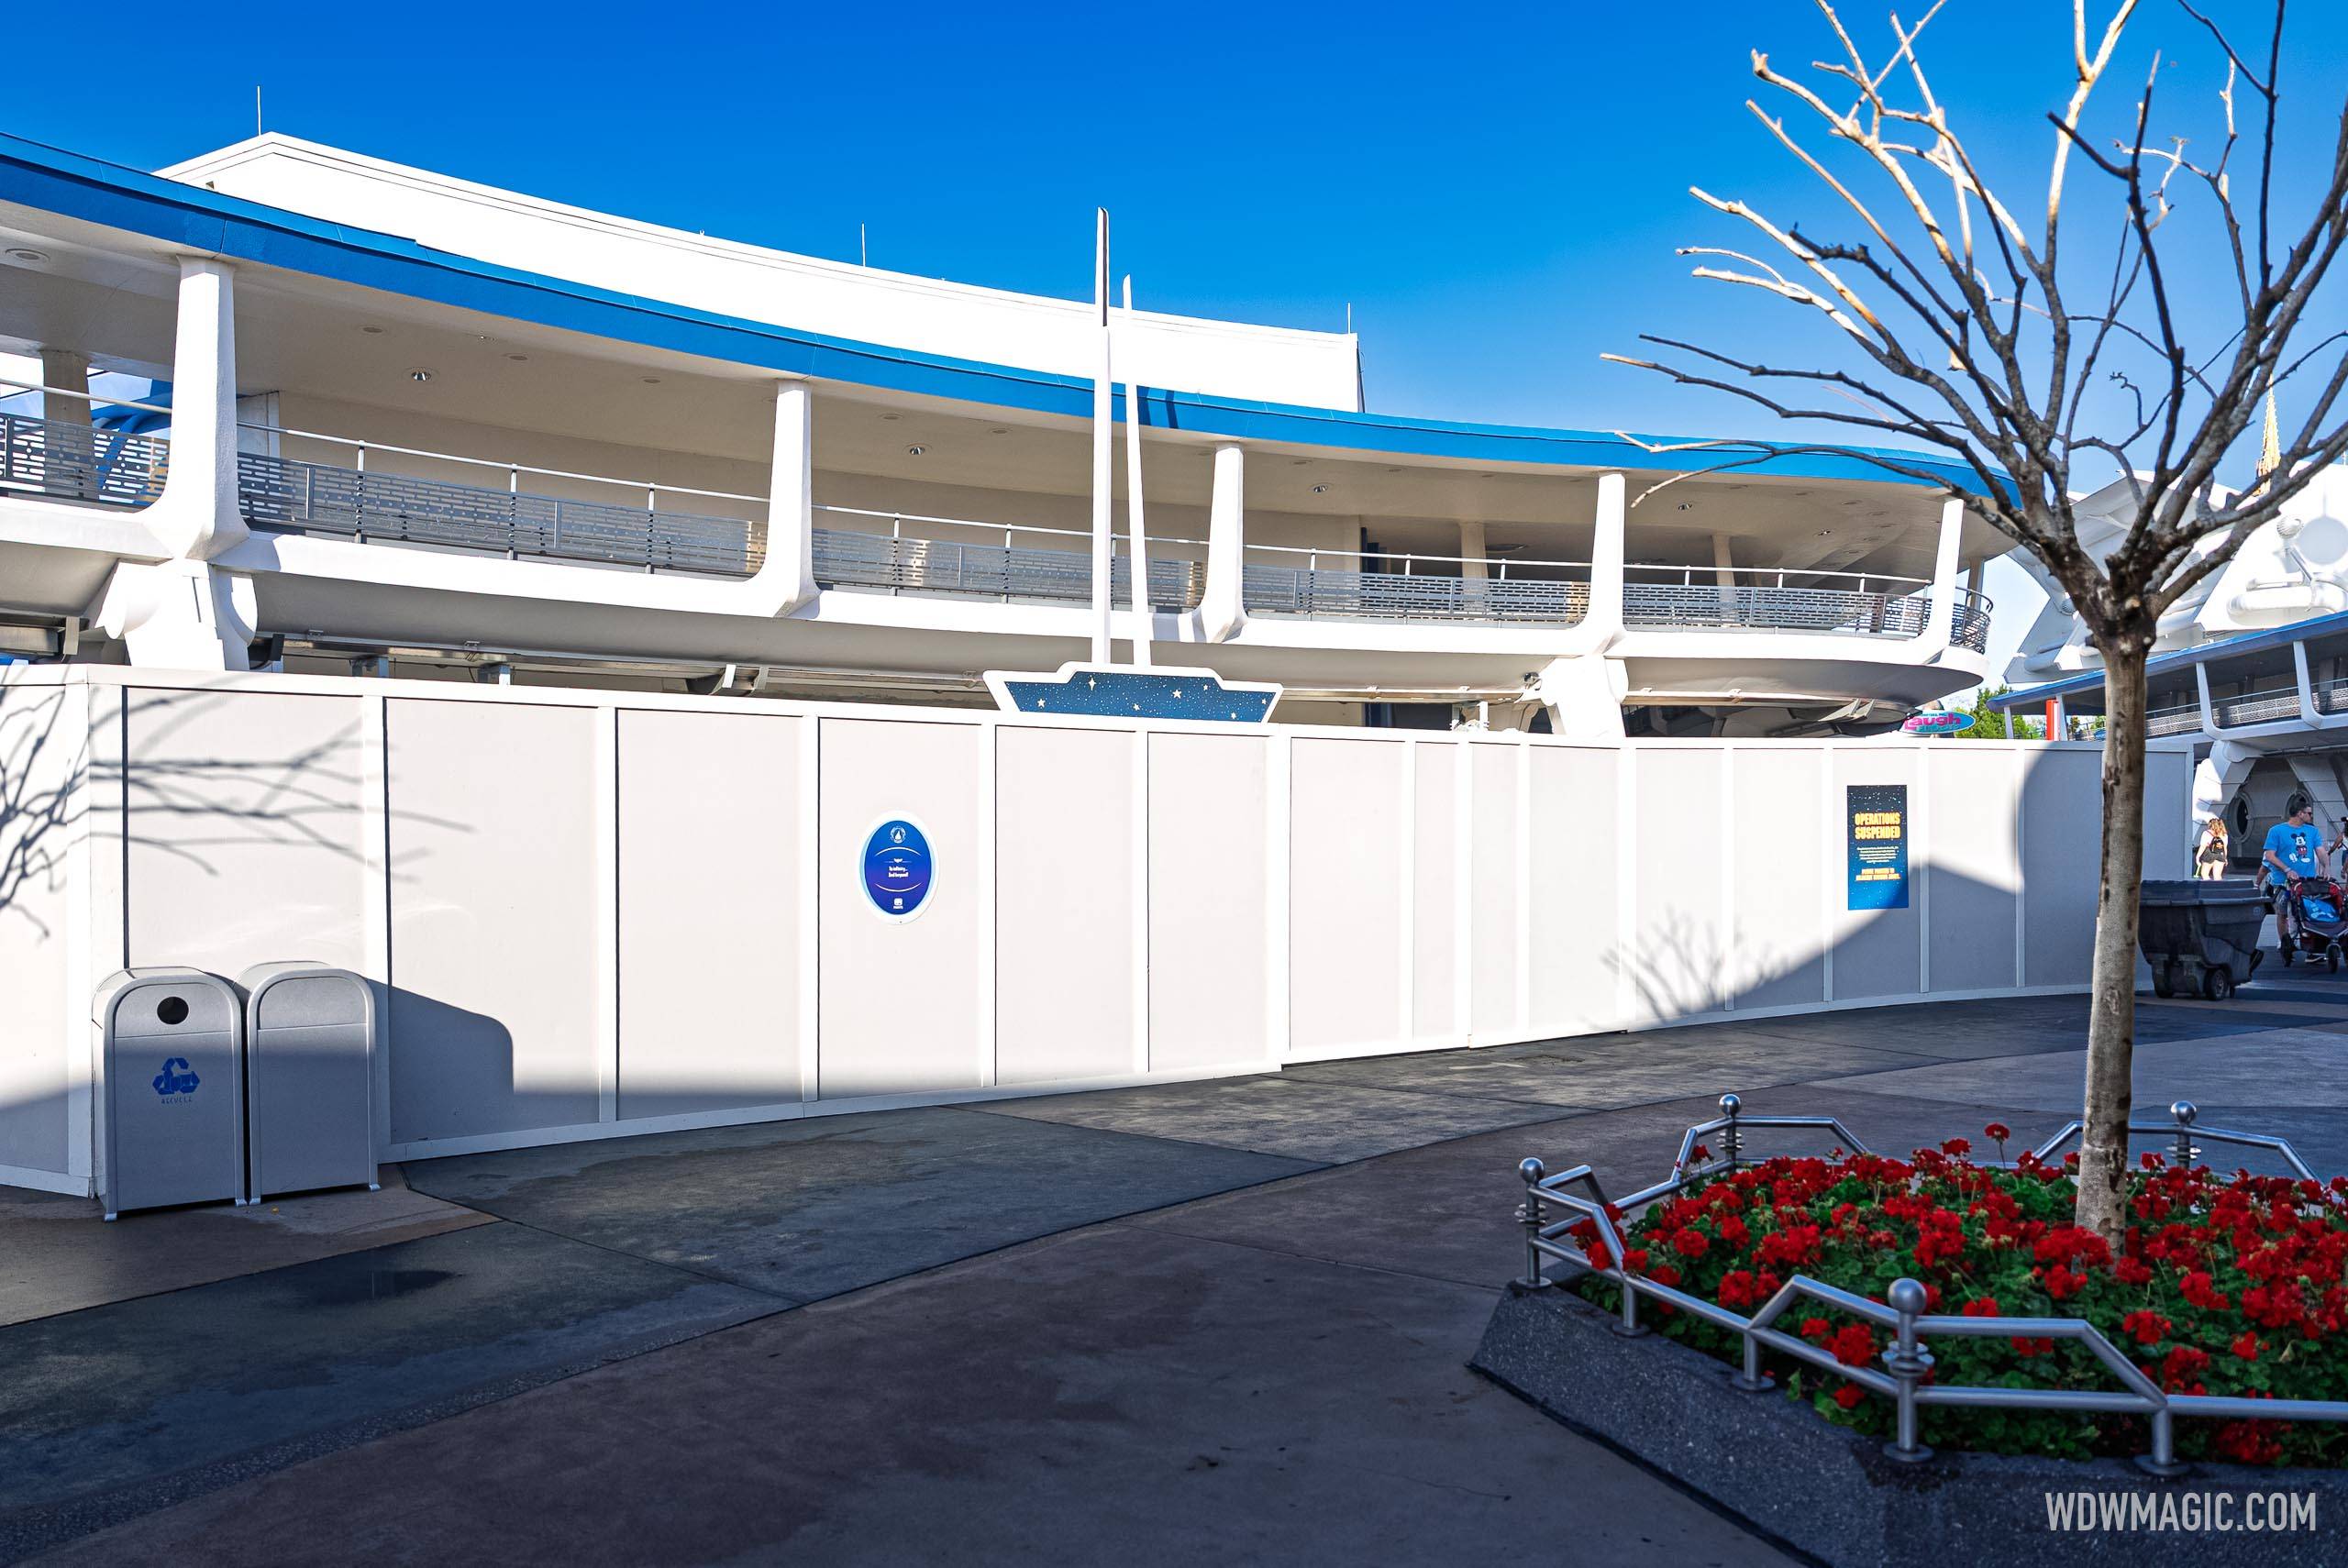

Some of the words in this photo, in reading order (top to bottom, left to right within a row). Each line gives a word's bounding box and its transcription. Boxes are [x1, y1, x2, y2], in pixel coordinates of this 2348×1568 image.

[1904, 712, 1961, 731] Laugh
[1855, 812, 1900, 825] OPERATIONS
[1855, 825, 1900, 840] SUSPENDED
